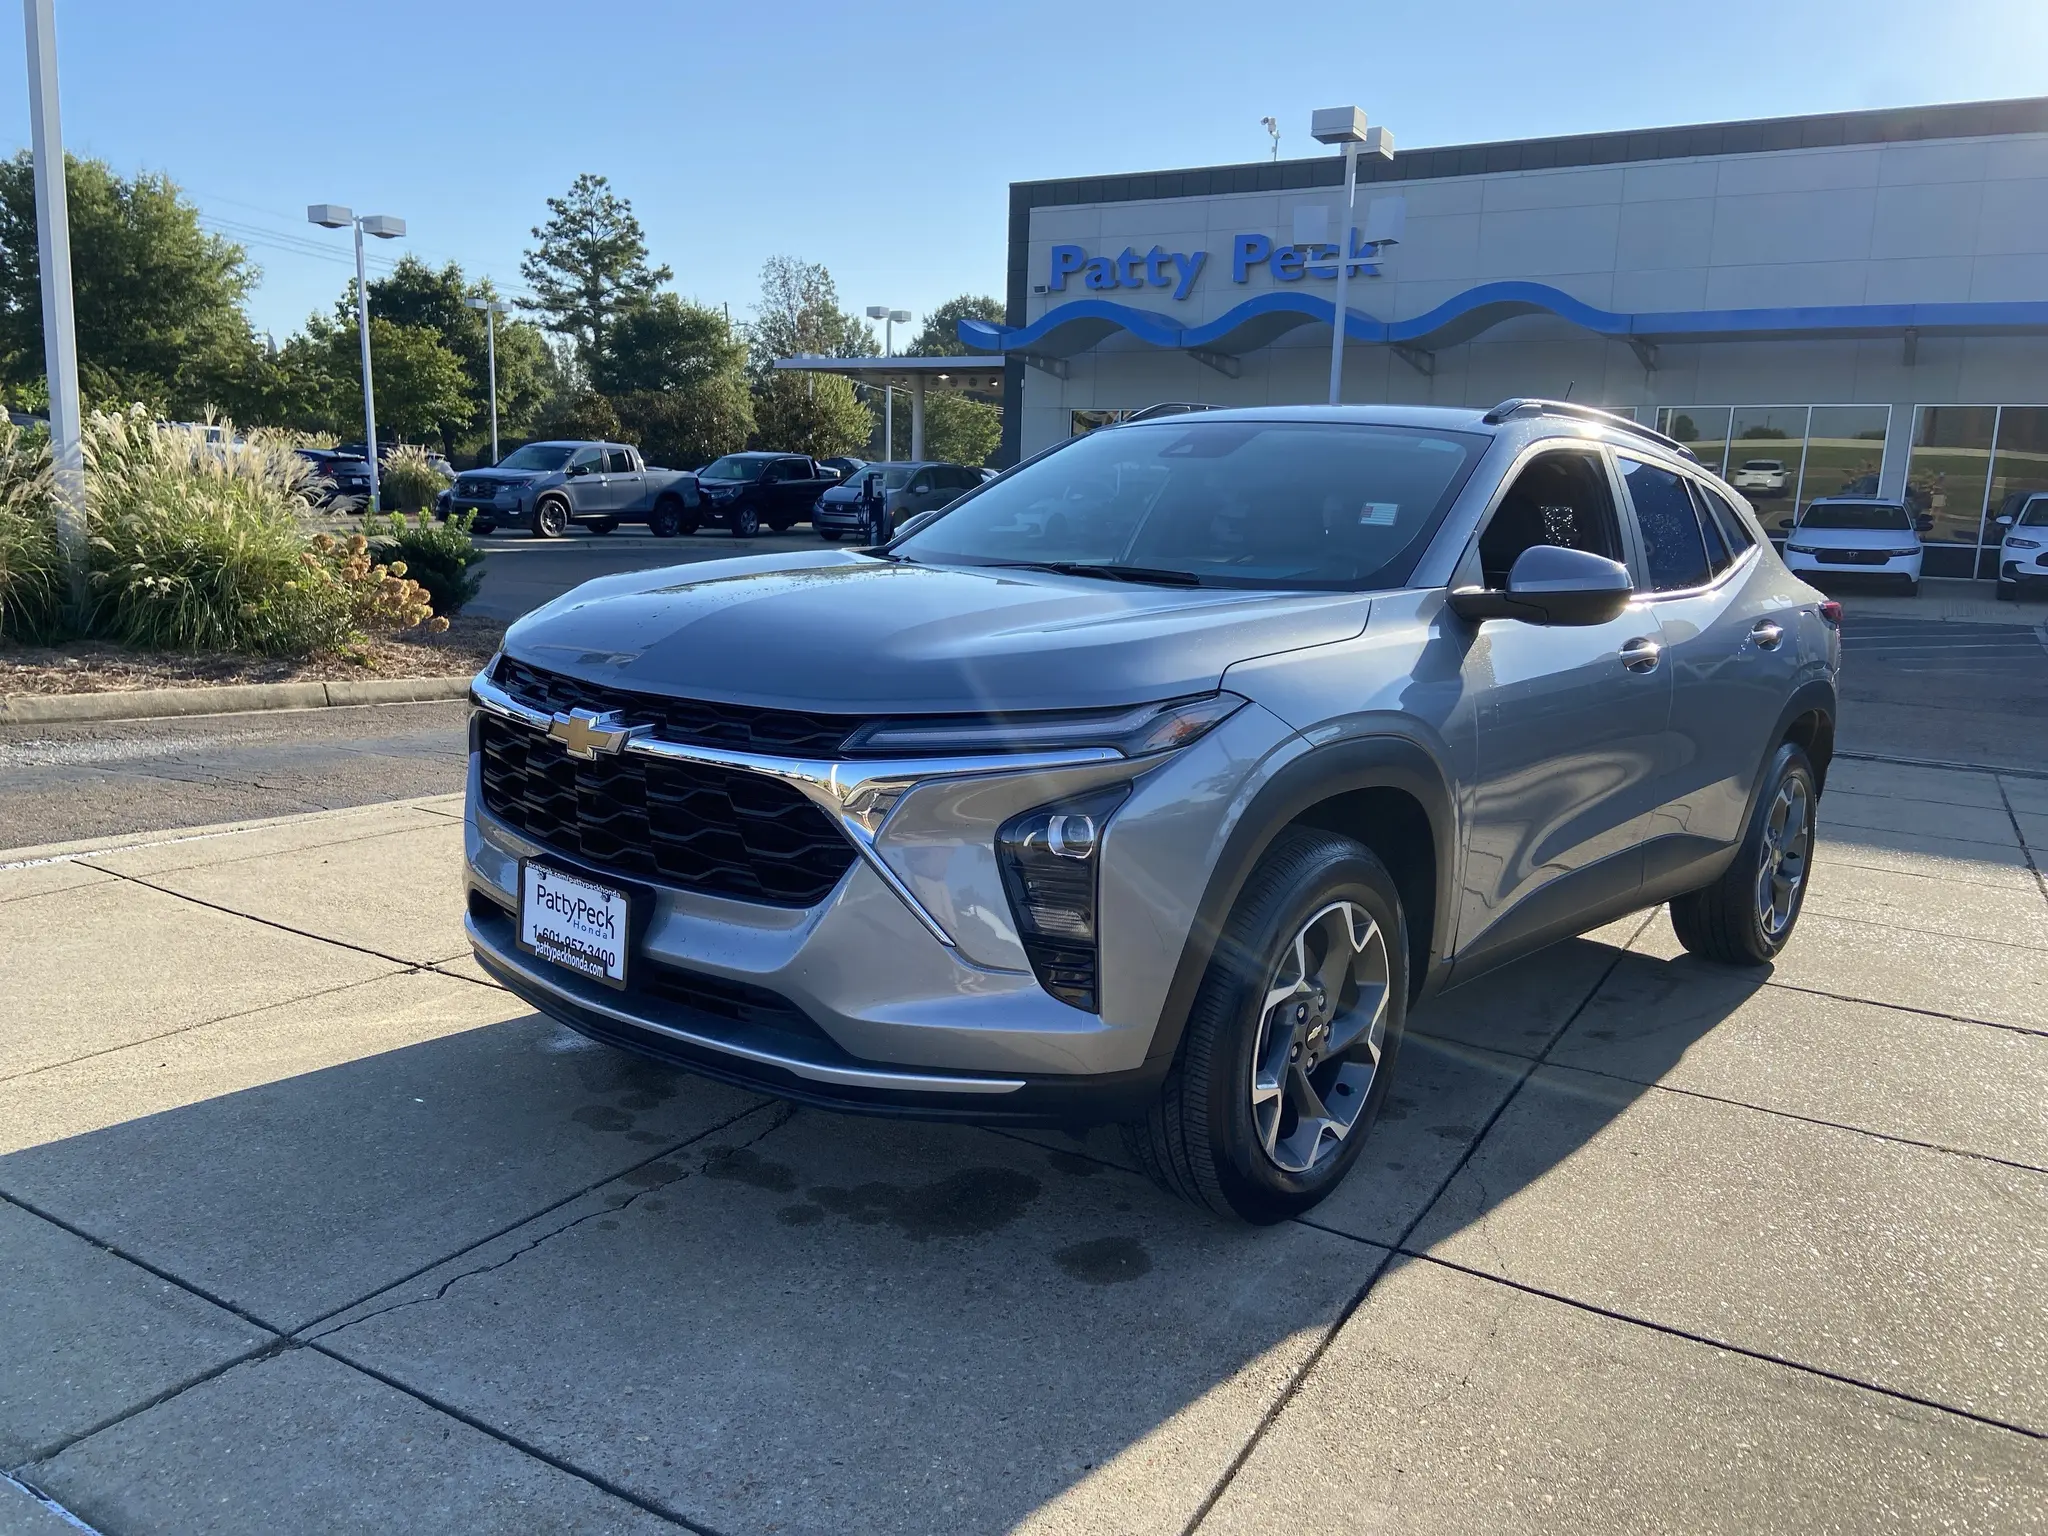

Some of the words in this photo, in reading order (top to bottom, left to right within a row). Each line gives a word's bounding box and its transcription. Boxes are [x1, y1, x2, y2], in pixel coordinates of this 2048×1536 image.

[1050, 244, 1208, 300] Patty
[1233, 227, 1381, 283] Peck
[526, 860, 621, 898] facebook.com/pattypeckhonda
[537, 884, 615, 939] PattyPeck
[573, 919, 608, 940] Honda
[534, 941, 605, 978] pattypeckhonda.com
